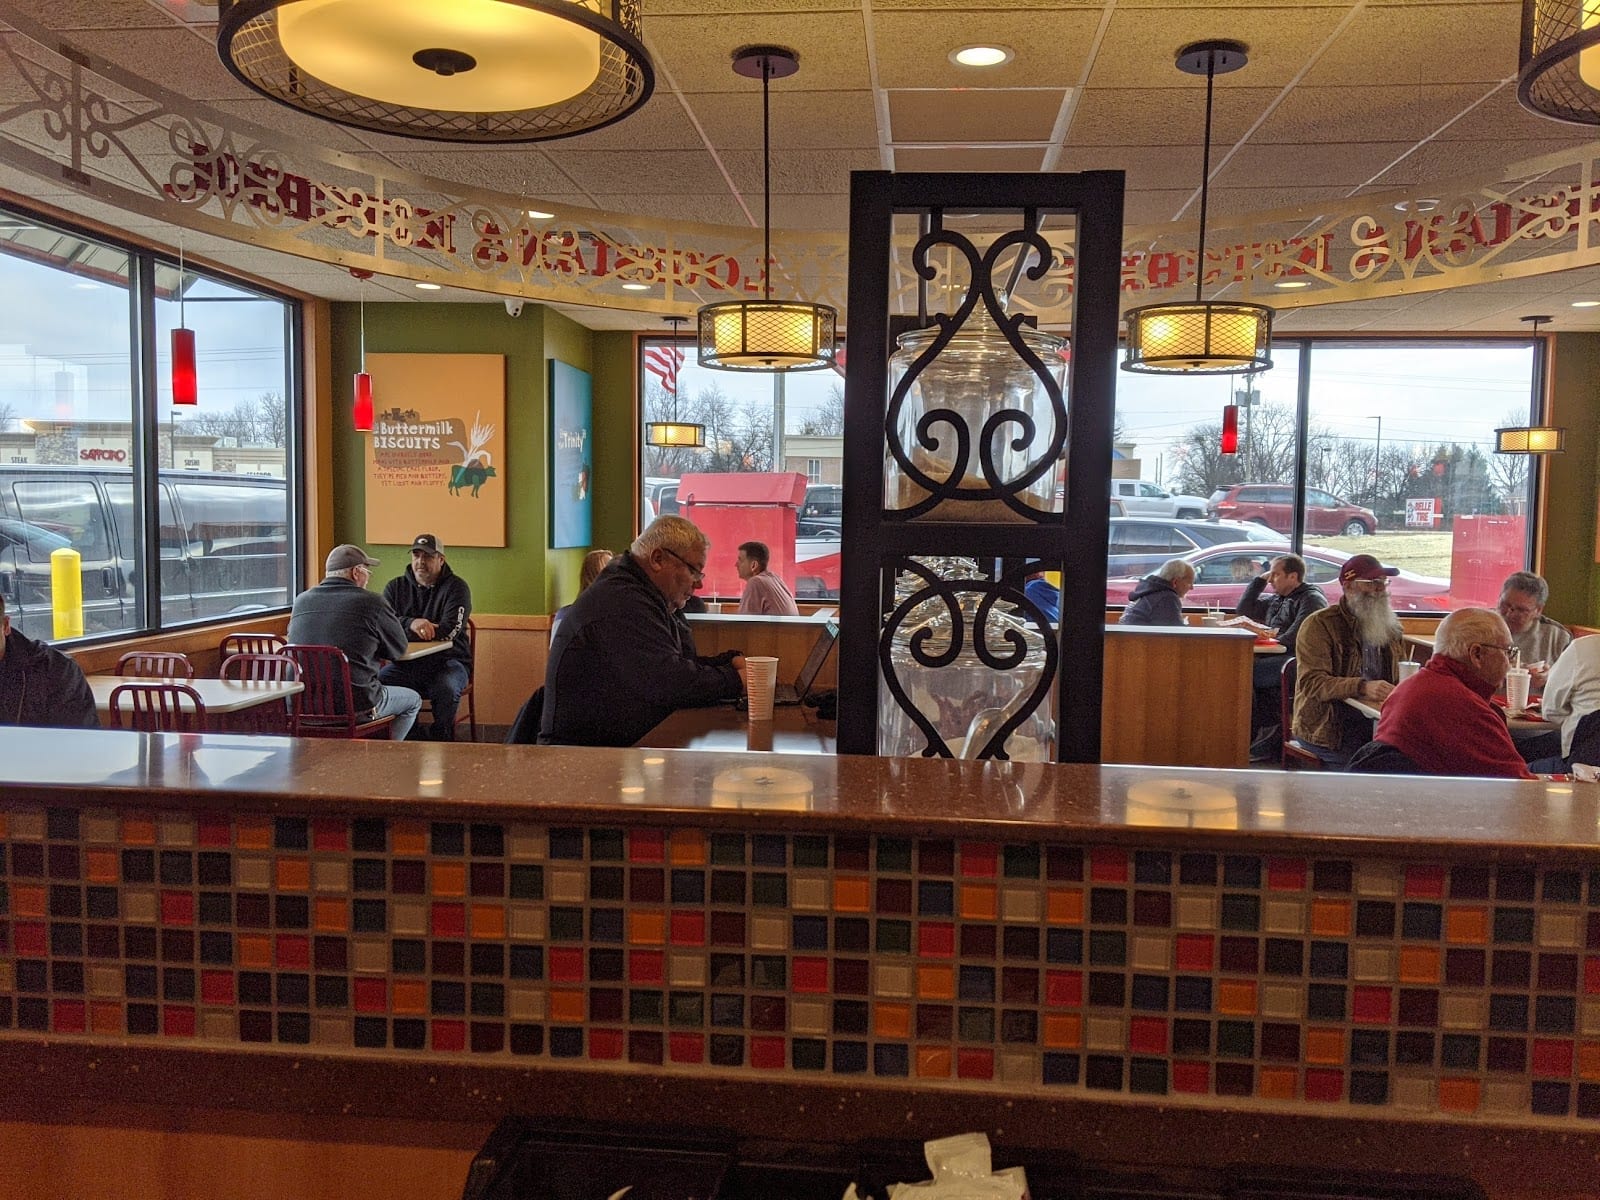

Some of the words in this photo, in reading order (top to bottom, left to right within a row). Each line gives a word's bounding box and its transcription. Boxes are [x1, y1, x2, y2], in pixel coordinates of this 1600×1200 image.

[381, 421, 453, 435] Buttermilk
[374, 436, 441, 449] BISCUITS
[11, 456, 28, 464] STEAK
[80, 449, 126, 462] SAPPORO
[1415, 501, 1432, 511] BELLE
[1416, 512, 1429, 522] TIRE
